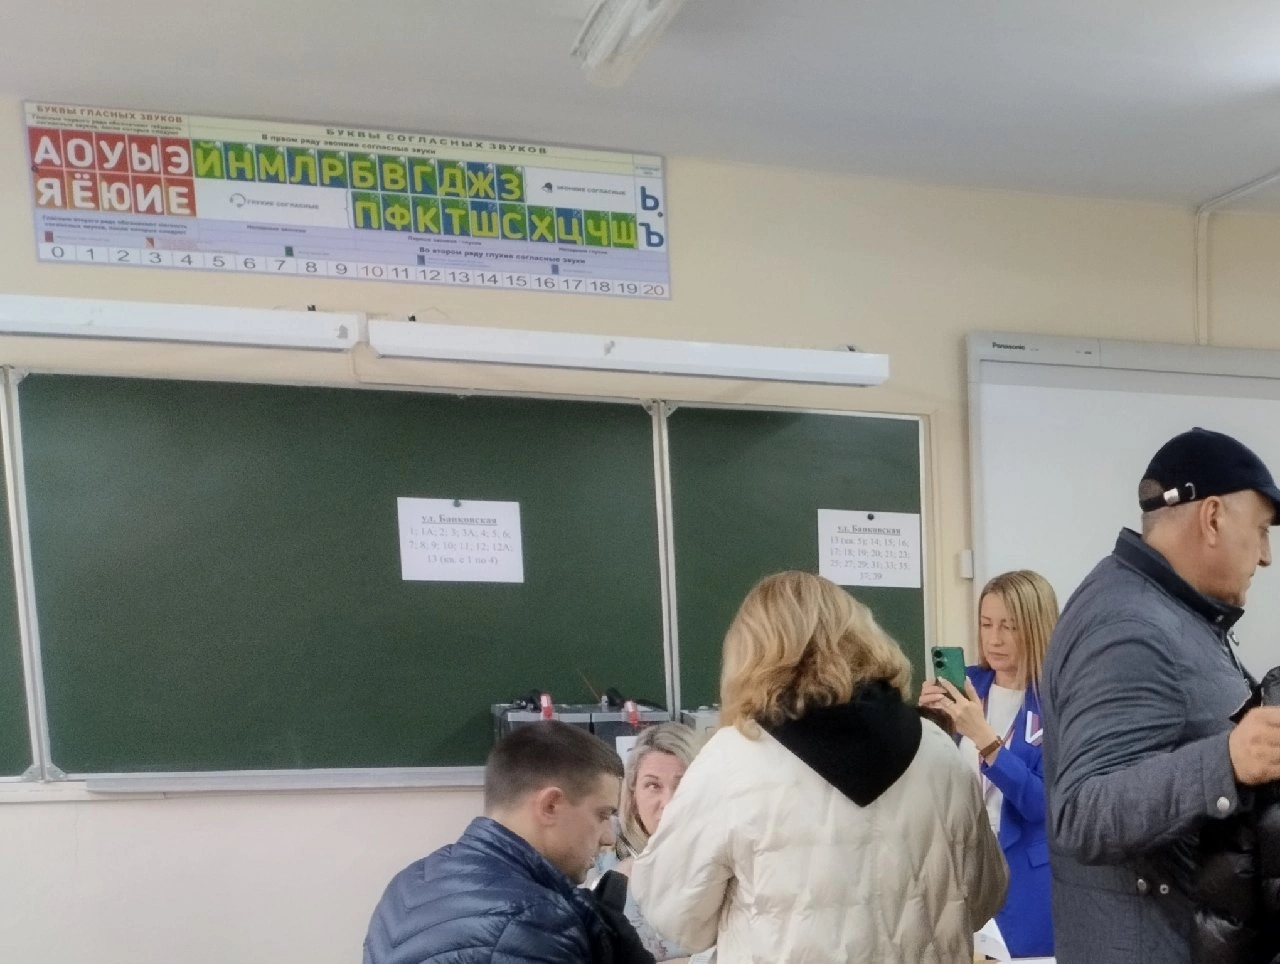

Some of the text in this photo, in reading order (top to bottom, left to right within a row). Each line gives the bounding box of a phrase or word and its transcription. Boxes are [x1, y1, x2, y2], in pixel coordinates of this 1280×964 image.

[37, 106, 76, 115] БУКВЫ
[80, 110, 136, 119] ГЛАСНЫХ
[141, 114, 183, 123] ЗВУКОВ
[326, 129, 546, 154] БУКВЫ СОГЛАСНЫХ ЗВУКОВ
[52, 246, 664, 296] 0 1 2 3 4 5 6 7 8 9 10 11 12 13 14 15 16 17 18 19 20
